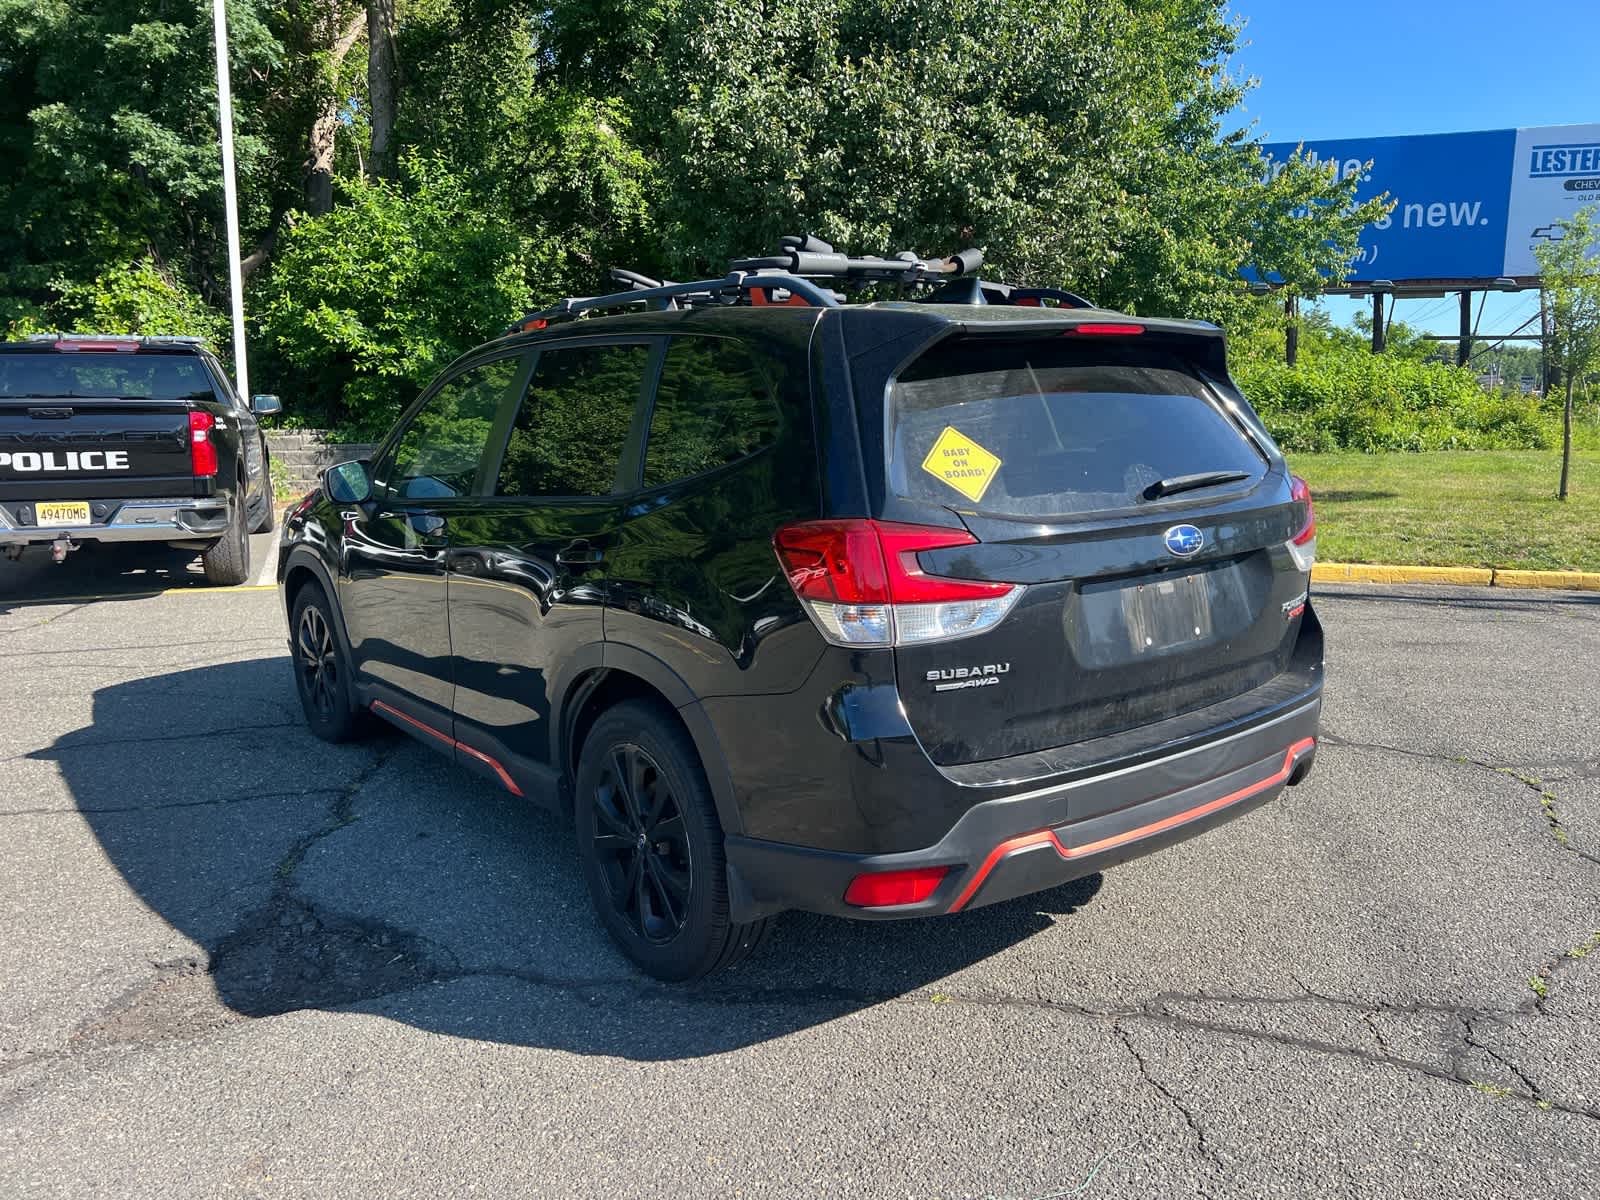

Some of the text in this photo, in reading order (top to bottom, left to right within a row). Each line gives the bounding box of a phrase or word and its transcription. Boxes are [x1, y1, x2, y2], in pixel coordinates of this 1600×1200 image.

[1403, 201, 1489, 229] new.
[942, 448, 970, 457] BABY
[952, 459, 968, 467] ON
[944, 468, 986, 479] BOARD!
[41, 508, 87, 520] 49470MG
[926, 662, 1010, 681] SUBARU
[963, 676, 1000, 689] AWD
